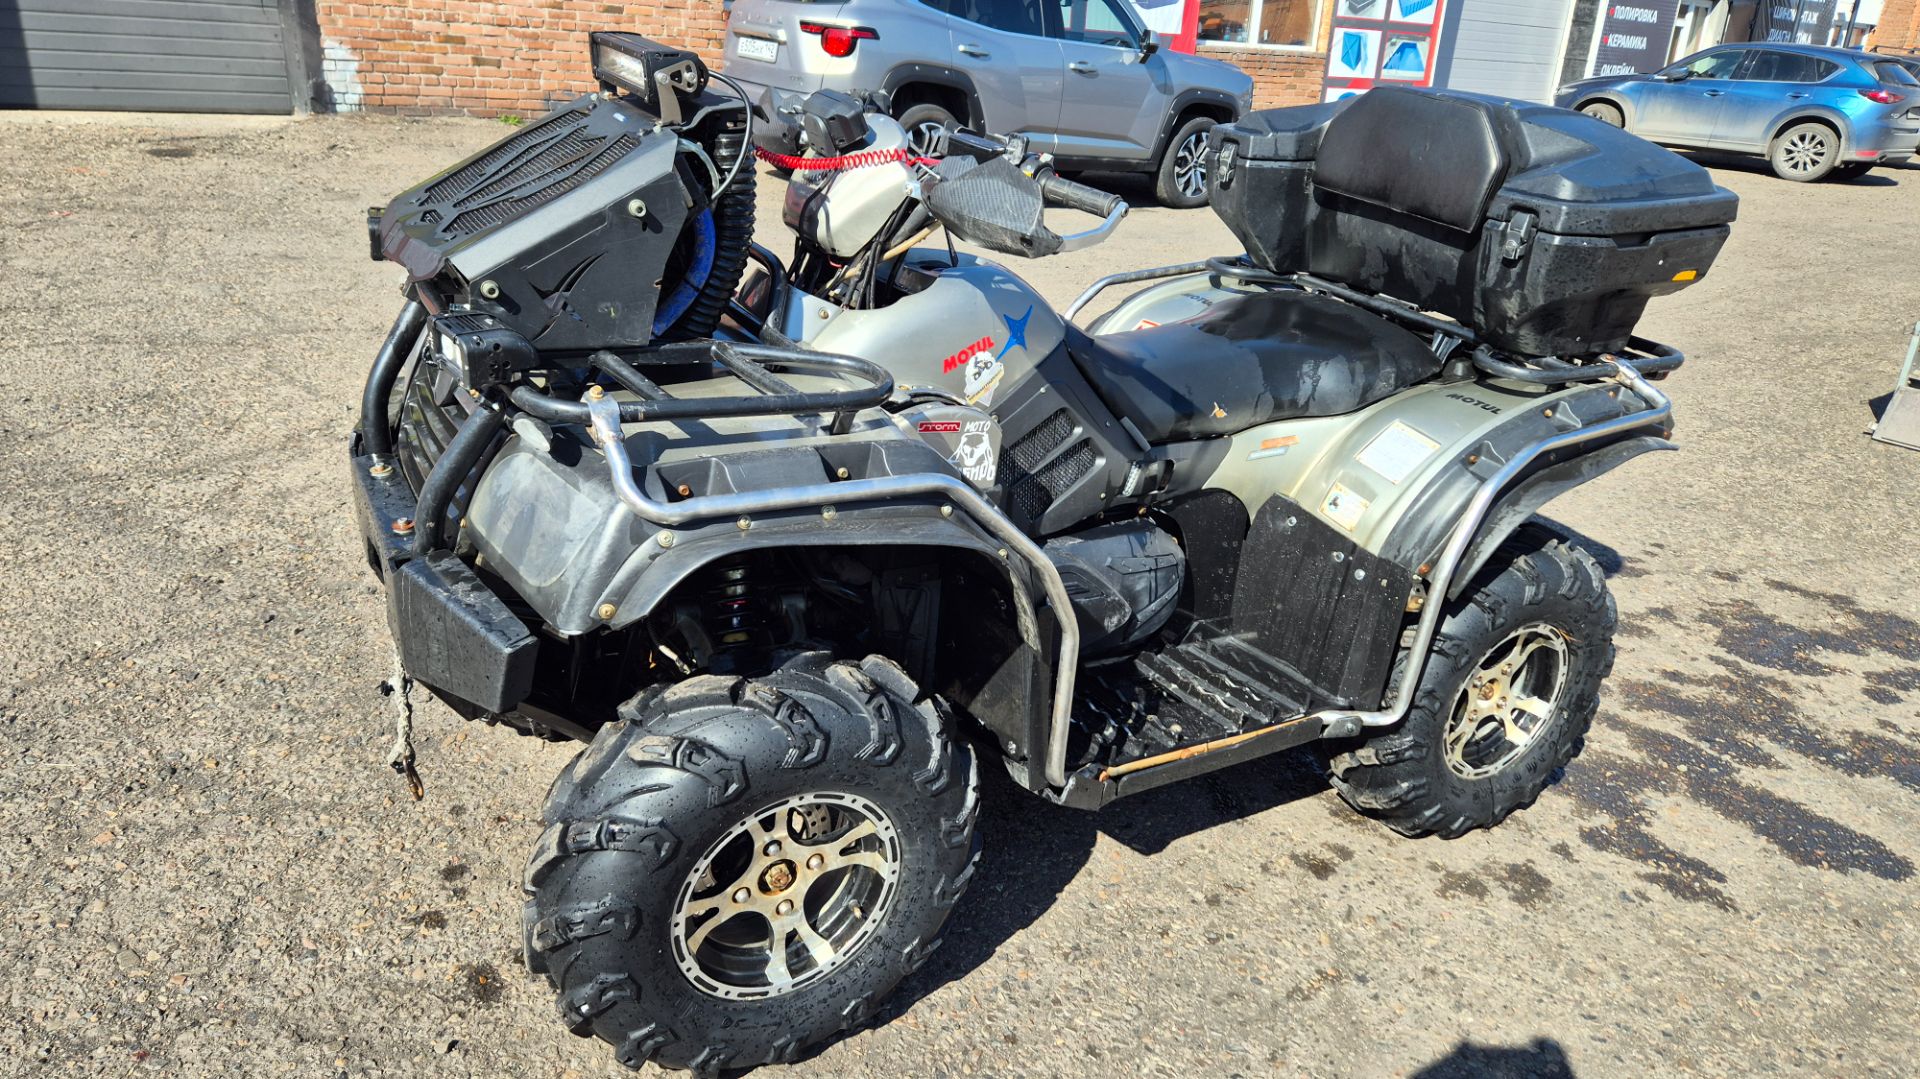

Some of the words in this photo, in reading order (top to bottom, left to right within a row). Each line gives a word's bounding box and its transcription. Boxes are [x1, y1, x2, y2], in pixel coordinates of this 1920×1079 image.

[1613, 5, 1658, 24] ПОЛИРОВКА
[1607, 33, 1648, 50] КЕРАМИКА
[943, 335, 995, 375] MOTUL
[1445, 394, 1501, 415] MOTUL
